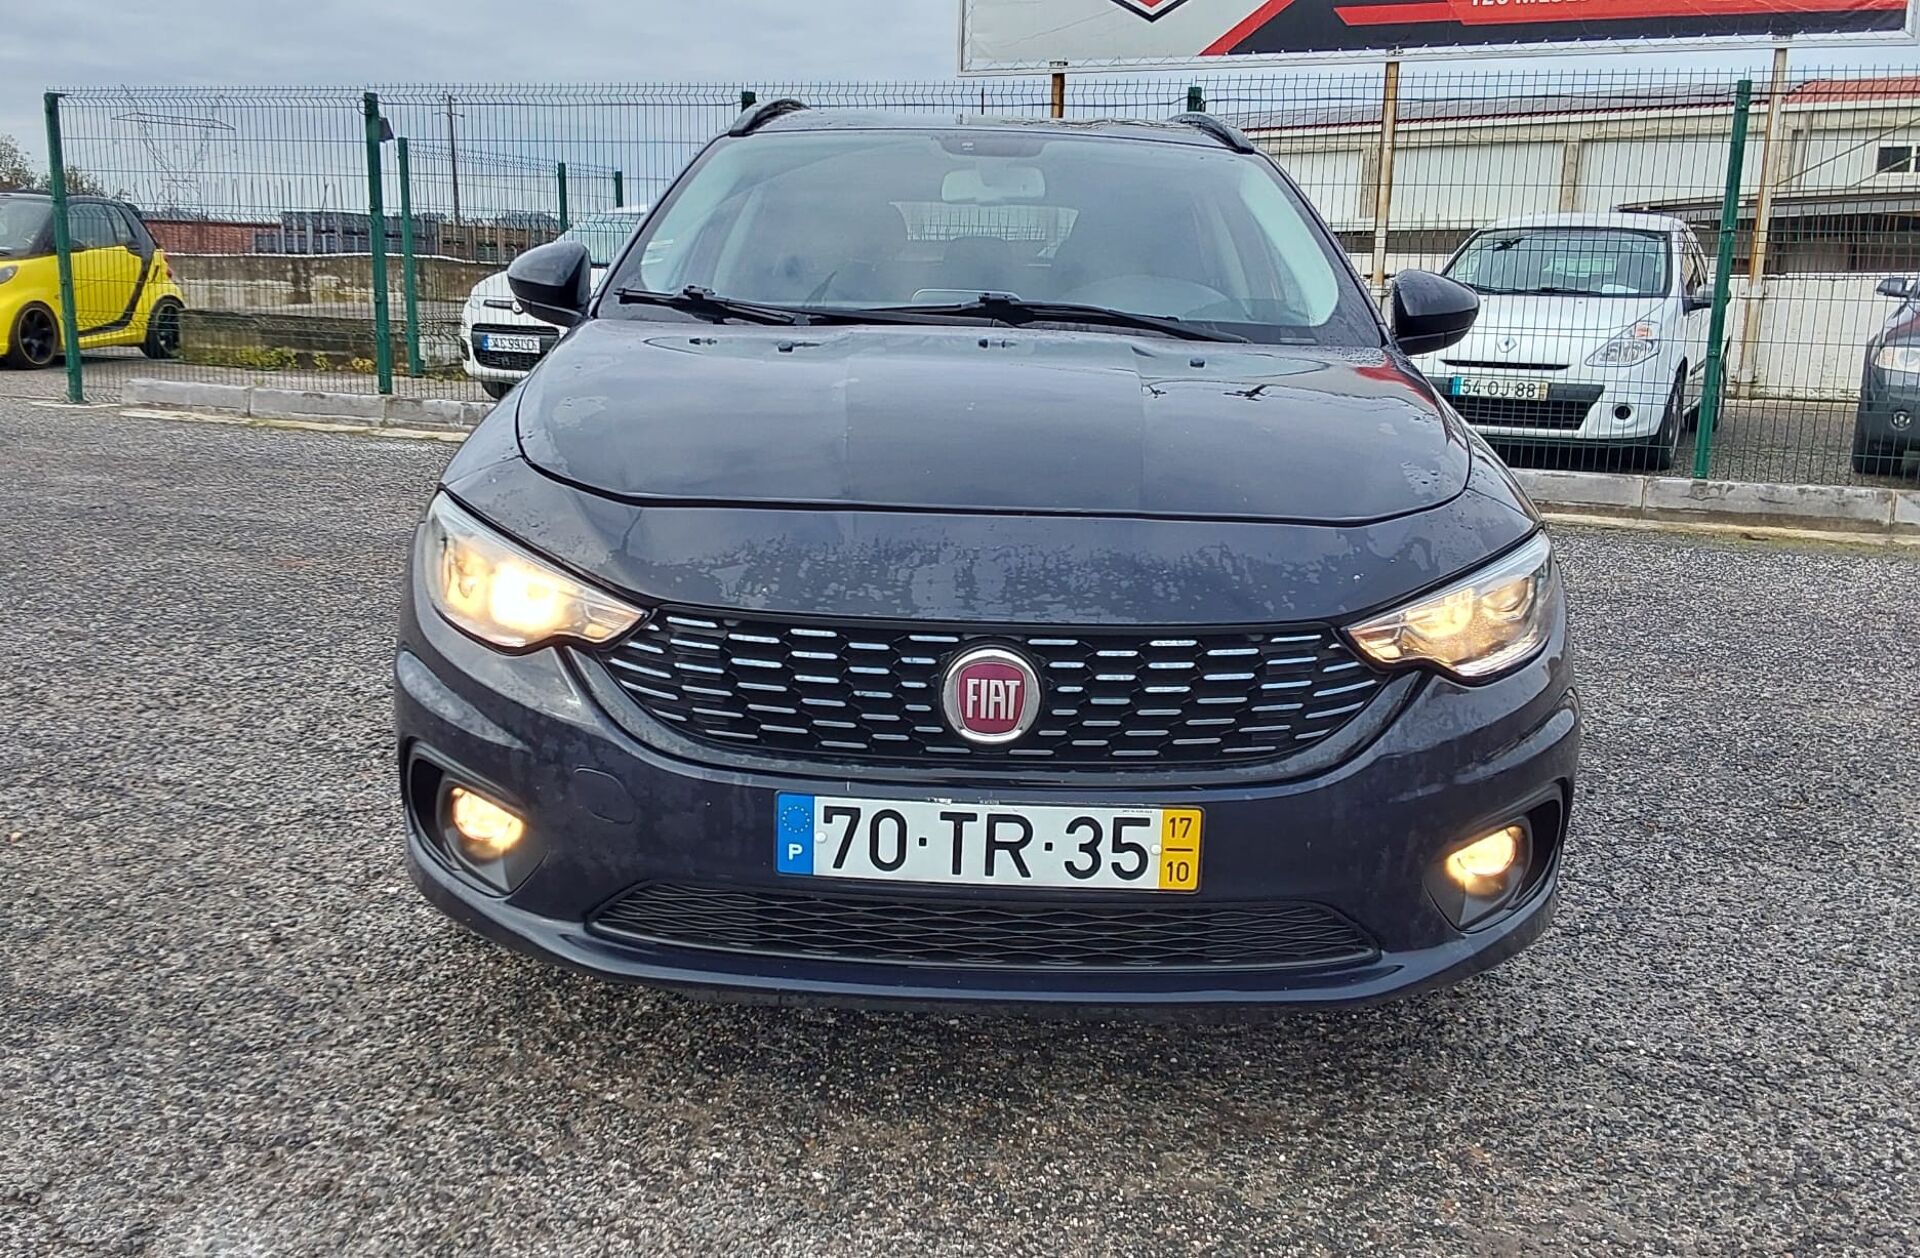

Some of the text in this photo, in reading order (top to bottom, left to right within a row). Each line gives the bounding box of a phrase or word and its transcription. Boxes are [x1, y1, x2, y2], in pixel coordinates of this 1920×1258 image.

[966, 678, 1021, 720] FIAT
[1168, 817, 1192, 839] 17
[788, 843, 803, 861] P
[1166, 861, 1190, 882] 10
